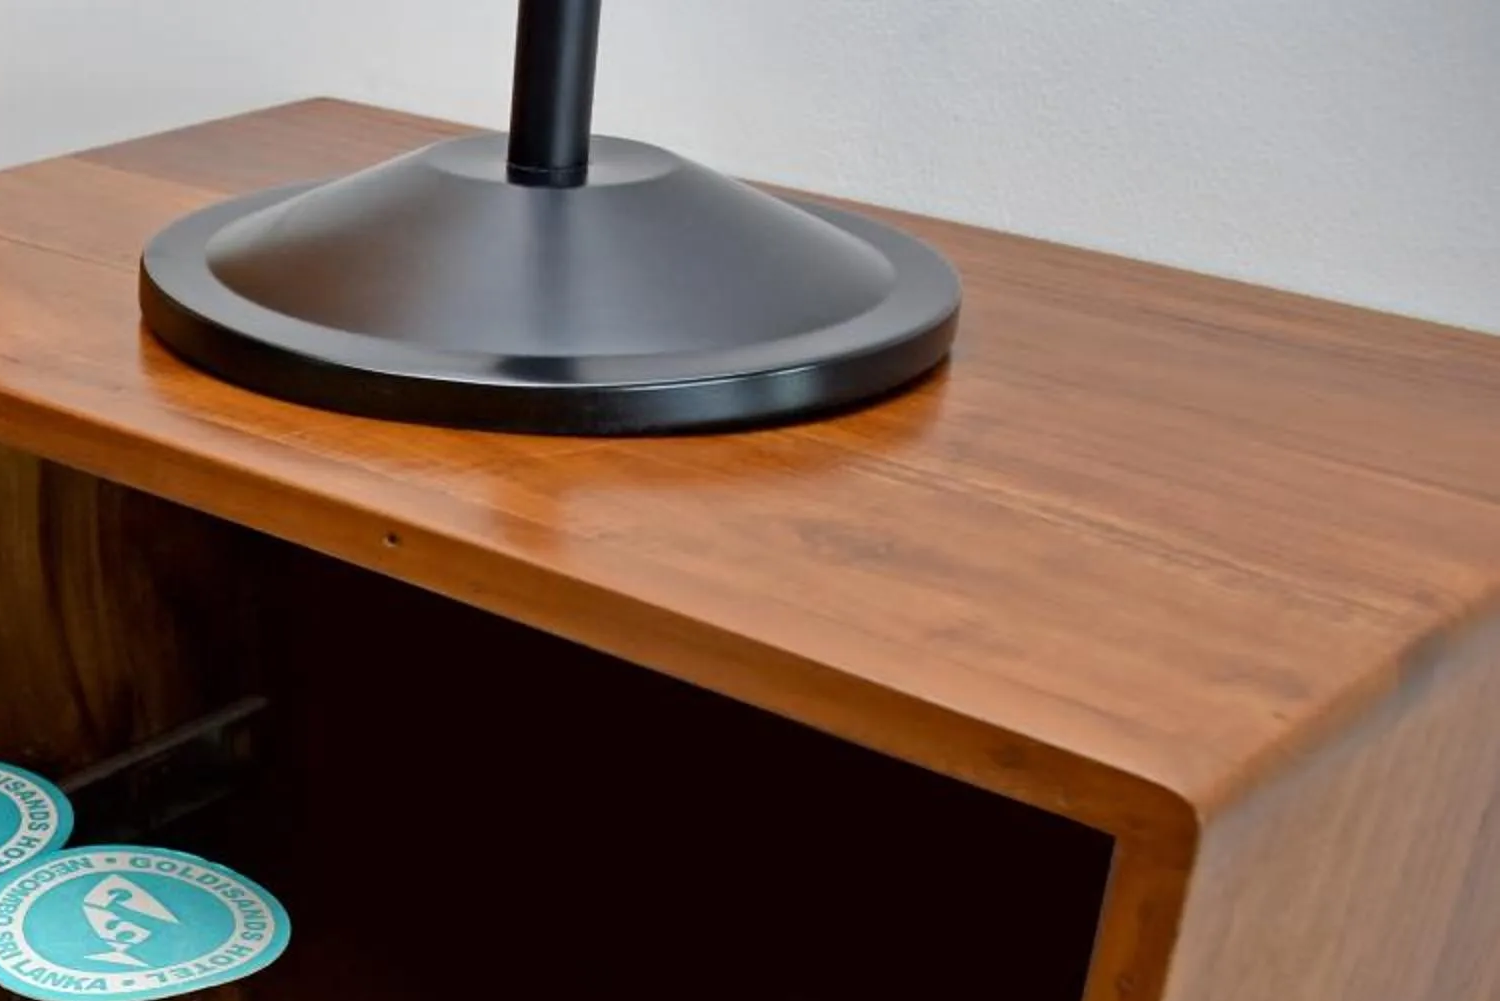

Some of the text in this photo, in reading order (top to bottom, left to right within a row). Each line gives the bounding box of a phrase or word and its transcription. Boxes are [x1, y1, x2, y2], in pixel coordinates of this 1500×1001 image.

[129, 856, 268, 982] GOLDISANDS HOTEL
[11, 958, 108, 991] LANKA
